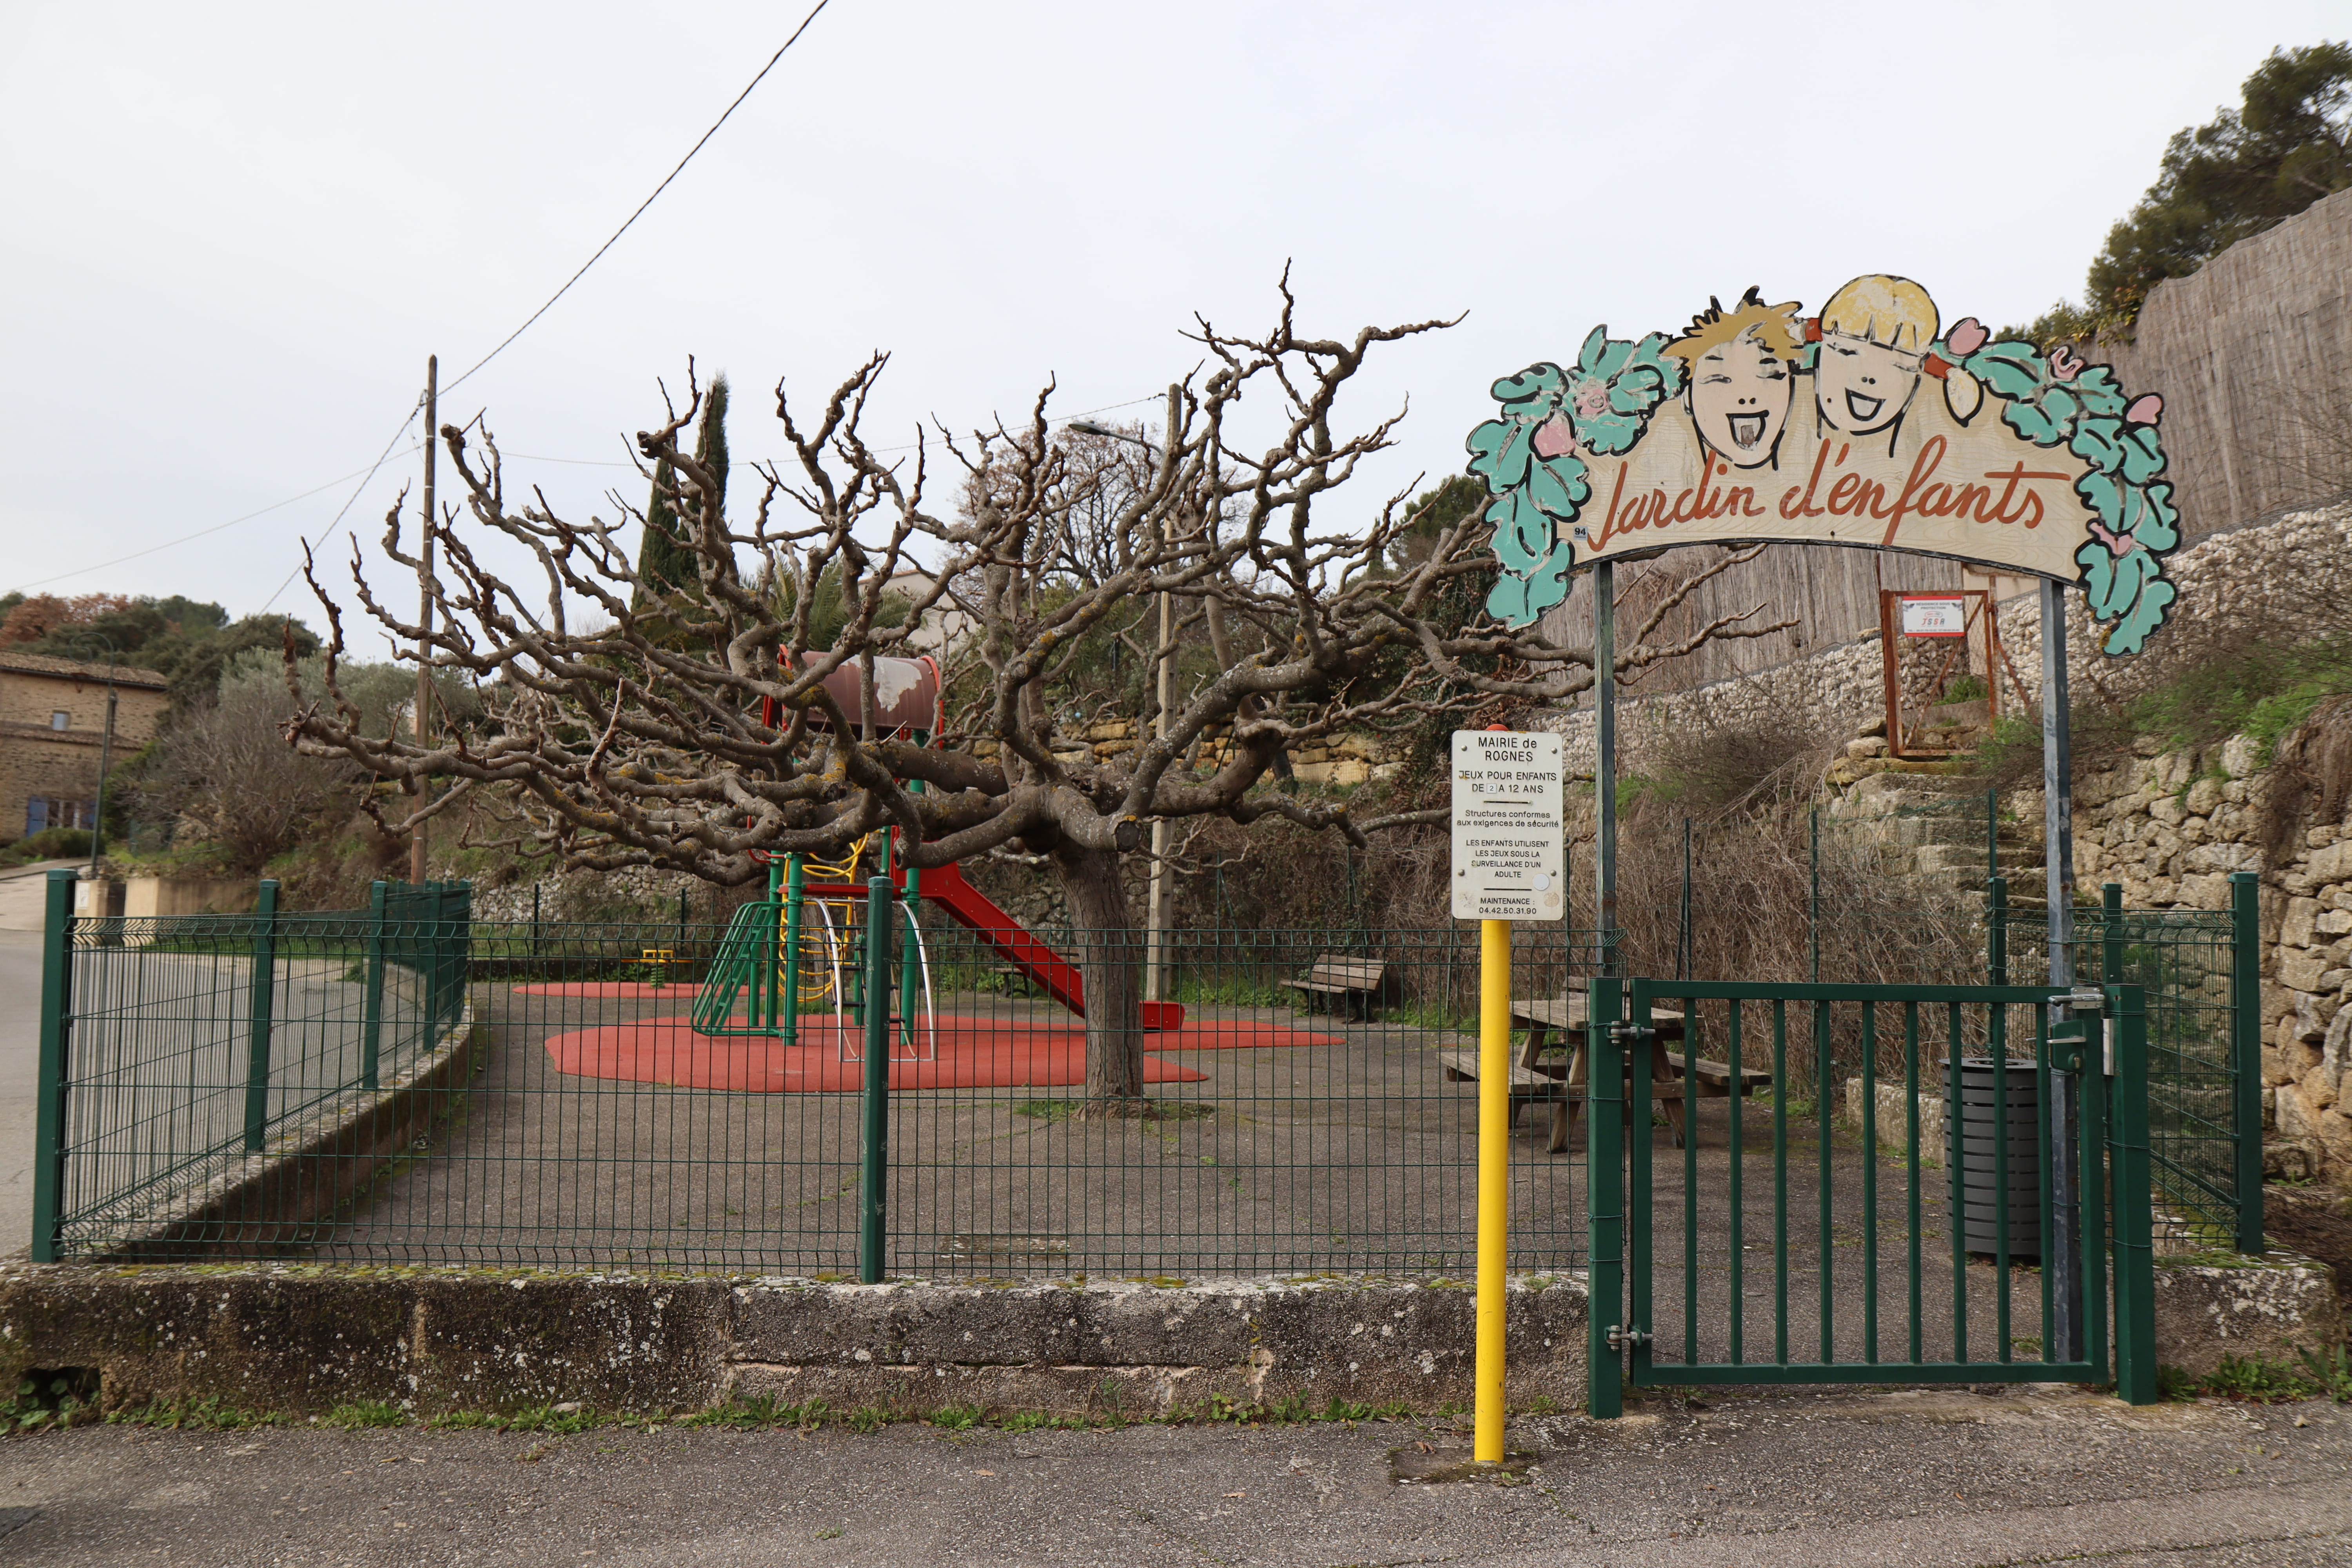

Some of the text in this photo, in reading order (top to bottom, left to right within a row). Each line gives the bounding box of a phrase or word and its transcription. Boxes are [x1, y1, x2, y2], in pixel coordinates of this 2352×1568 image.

[1588, 434, 2071, 552] Jardin d'enfants
[1478, 737, 1537, 748] MAIRIE de
[1485, 750, 1533, 762] ROGNES
[1459, 771, 1557, 780] JEUX POUR ENFANTS
[1472, 784, 1484, 792] DE
[1509, 784, 1519, 793] 12
[1523, 785, 1543, 793] ANS
